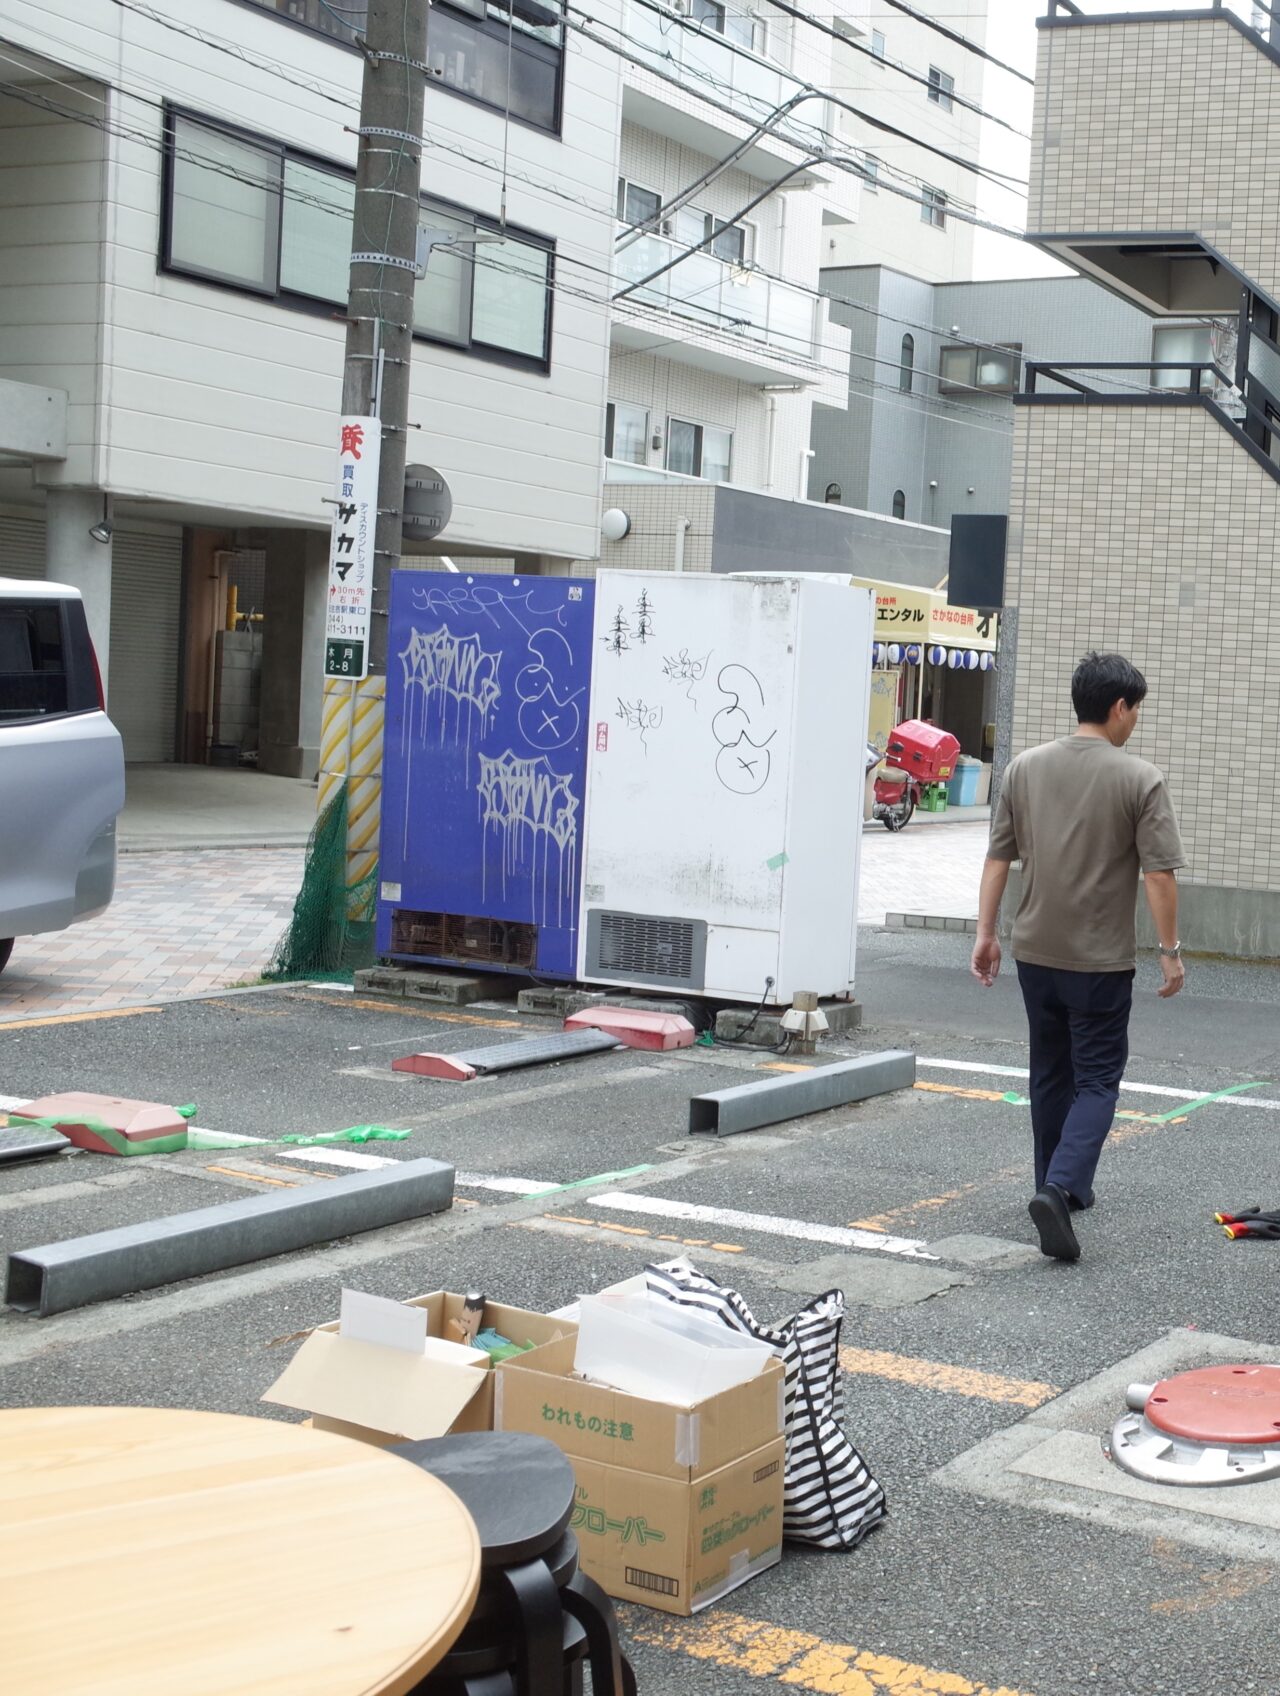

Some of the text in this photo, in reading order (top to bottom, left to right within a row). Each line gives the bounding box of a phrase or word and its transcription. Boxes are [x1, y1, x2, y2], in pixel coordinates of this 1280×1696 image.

[340, 424, 364, 460] 質
[342, 464, 355, 498] 買取
[336, 503, 357, 581] サカマ
[932, 609, 974, 626] さかなの台所
[330, 660, 349, 672] 2-8
[542, 1403, 635, 1441] われもの注意
